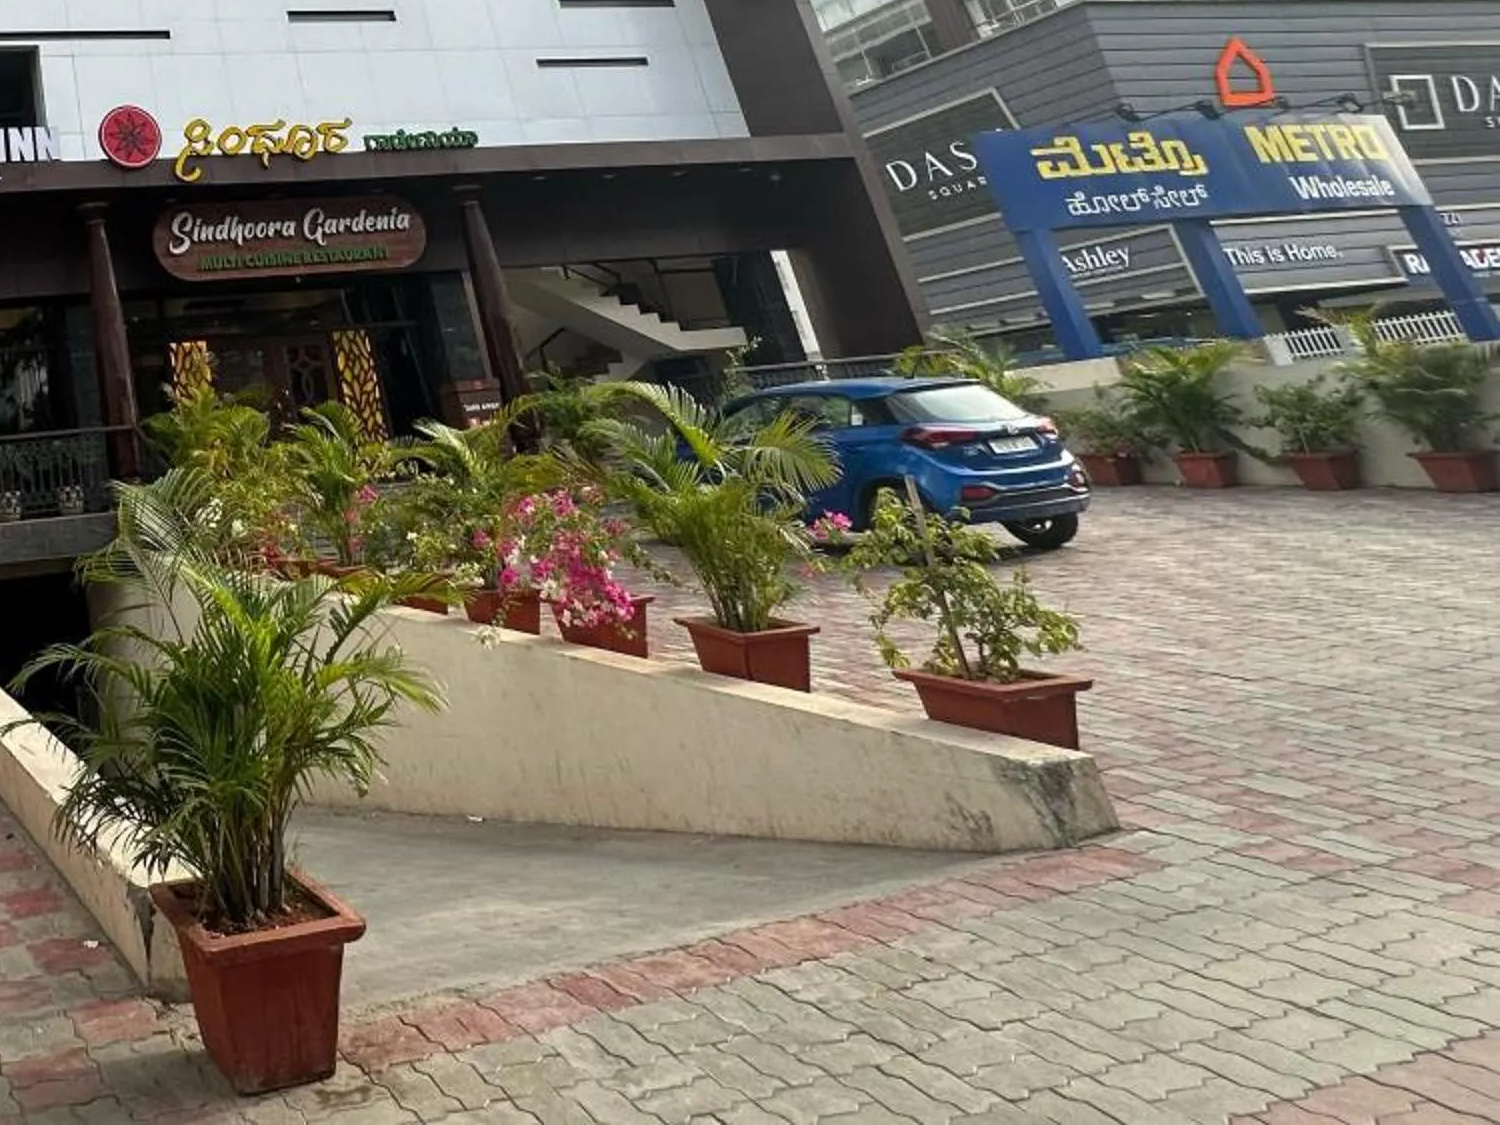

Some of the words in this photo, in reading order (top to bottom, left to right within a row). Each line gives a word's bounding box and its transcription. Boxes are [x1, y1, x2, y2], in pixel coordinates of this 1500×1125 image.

[1244, 122, 1389, 164] METRO
[1291, 173, 1395, 200] Wholesale
[168, 210, 296, 255] Sindhoora
[302, 205, 411, 246] Gardenia
[201, 254, 243, 271] MULTI
[245, 251, 301, 268] CUISINE
[303, 245, 389, 265] RESTAURANT
[1222, 246, 1265, 266] This
[1266, 245, 1284, 262] is
